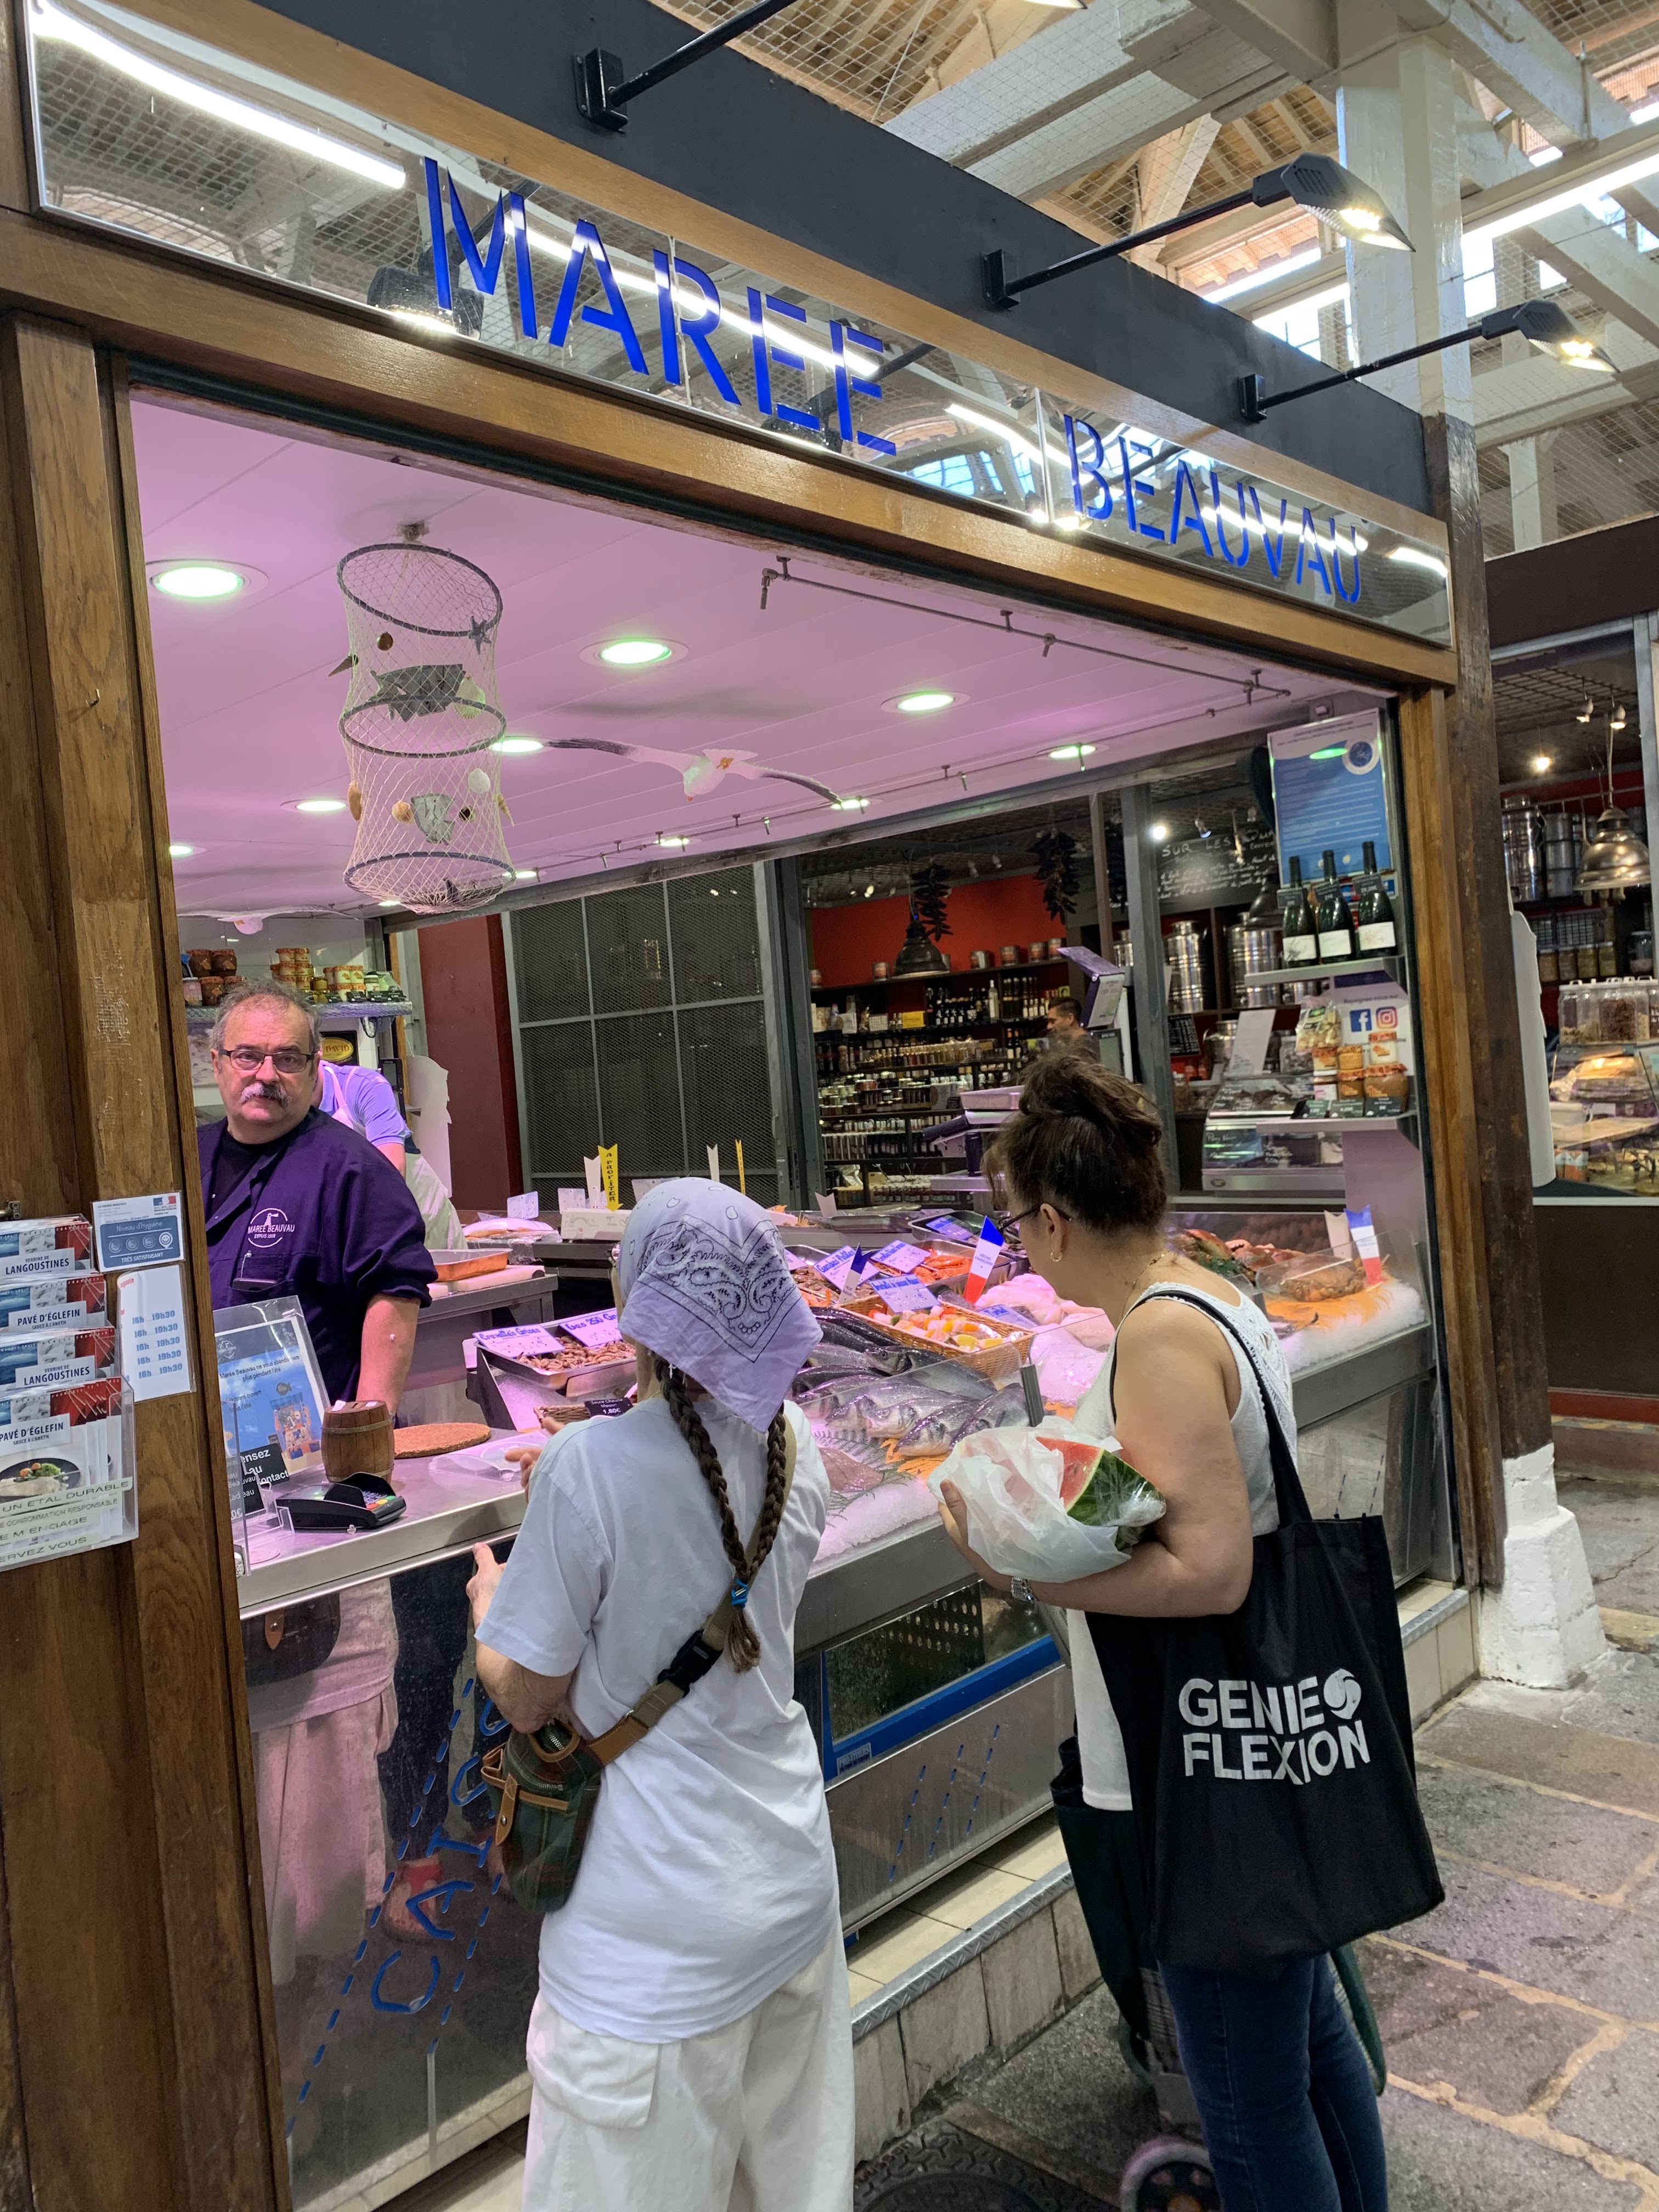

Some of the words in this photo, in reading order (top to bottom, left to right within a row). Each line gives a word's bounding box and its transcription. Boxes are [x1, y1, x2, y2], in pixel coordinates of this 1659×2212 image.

[425, 156, 896, 456] MAREE
[1063, 414, 1361, 605] BEAUVAU
[1162, 843, 1192, 857] SUR
[136, 1221, 163, 1231] d'hygiène
[267, 1224, 295, 1233] BEAUVAU
[133, 1252, 164, 1261] SATISFAISANT
[6, 1259, 70, 1275] LANGOUSTINES
[18, 1314, 37, 1326] PAVÉ
[24, 1366, 90, 1386] LANGOUSTINES
[220, 1370, 235, 1379] Marée
[235, 1366, 256, 1375] Beauvau
[242, 1375, 252, 1383] plus
[253, 1370, 271, 1381] pendant
[247, 1390, 262, 1399] ouvert
[0, 1430, 18, 1442] PAVÉ
[240, 1449, 271, 1464] ensez
[249, 1465, 263, 1475] au
[3, 1502, 21, 1513] UN
[27, 1495, 61, 1507] ETAL
[66, 1481, 129, 1499] DURABLE
[7, 1509, 66, 1527] CONSOMMATION
[67, 1498, 118, 1514] RESPONSABLE
[49, 1537, 87, 1550] VOUS
[1178, 1676, 1325, 1735] GENIE
[1183, 1719, 1371, 1785] FLEXION
